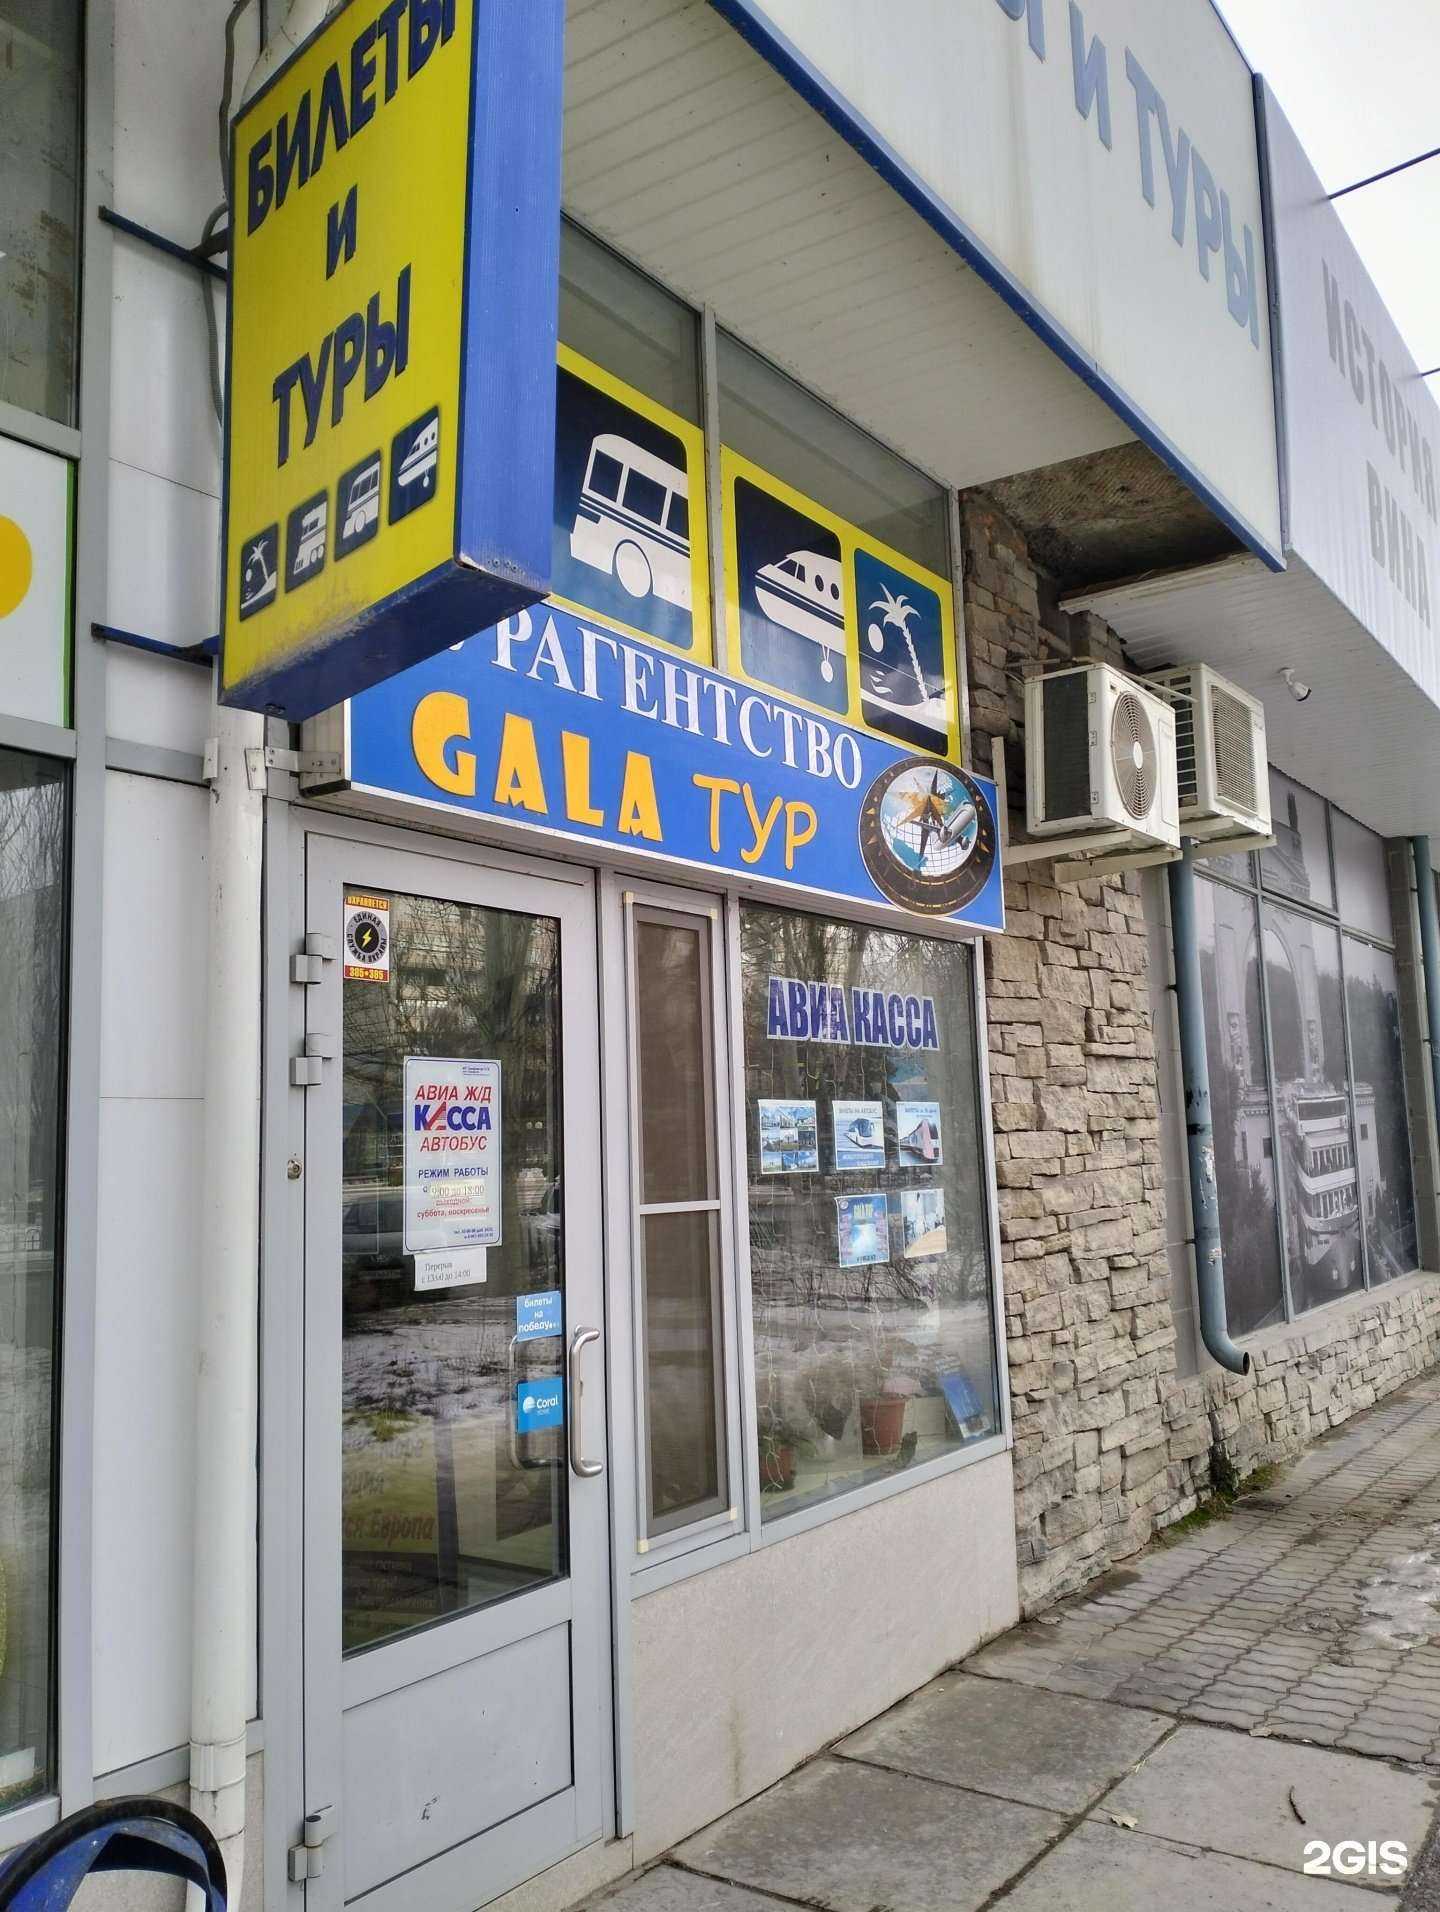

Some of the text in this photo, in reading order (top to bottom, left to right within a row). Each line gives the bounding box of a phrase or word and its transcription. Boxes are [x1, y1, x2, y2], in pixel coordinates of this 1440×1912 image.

[248, 0, 457, 237] БИЛЕТЫ
[1068, 0, 1259, 350] И ТУРЫ
[326, 184, 358, 281] И
[272, 262, 412, 470] ТУРЫ
[1322, 257, 1438, 526] ИСТОРИЯ
[1366, 459, 1431, 630] ВИНА
[449, 608, 863, 790] РАГЕНТСТВО
[411, 690, 818, 871] GALA ТУР
[353, 911, 381, 927] ЕДИНАЯ
[347, 933, 366, 962] СЛУЖБА
[767, 977, 939, 1050] АВИА КАССА
[415, 1085, 492, 1103] АВИА Ж/Д
[415, 1101, 491, 1131] КАССА
[420, 1136, 487, 1152] АВТОБУС
[418, 1166, 489, 1179] РЕЖИМ РАБОТЫ
[524, 1297, 553, 1308] билеты
[534, 1311, 544, 1319] на
[536, 1394, 558, 1409] Coral
